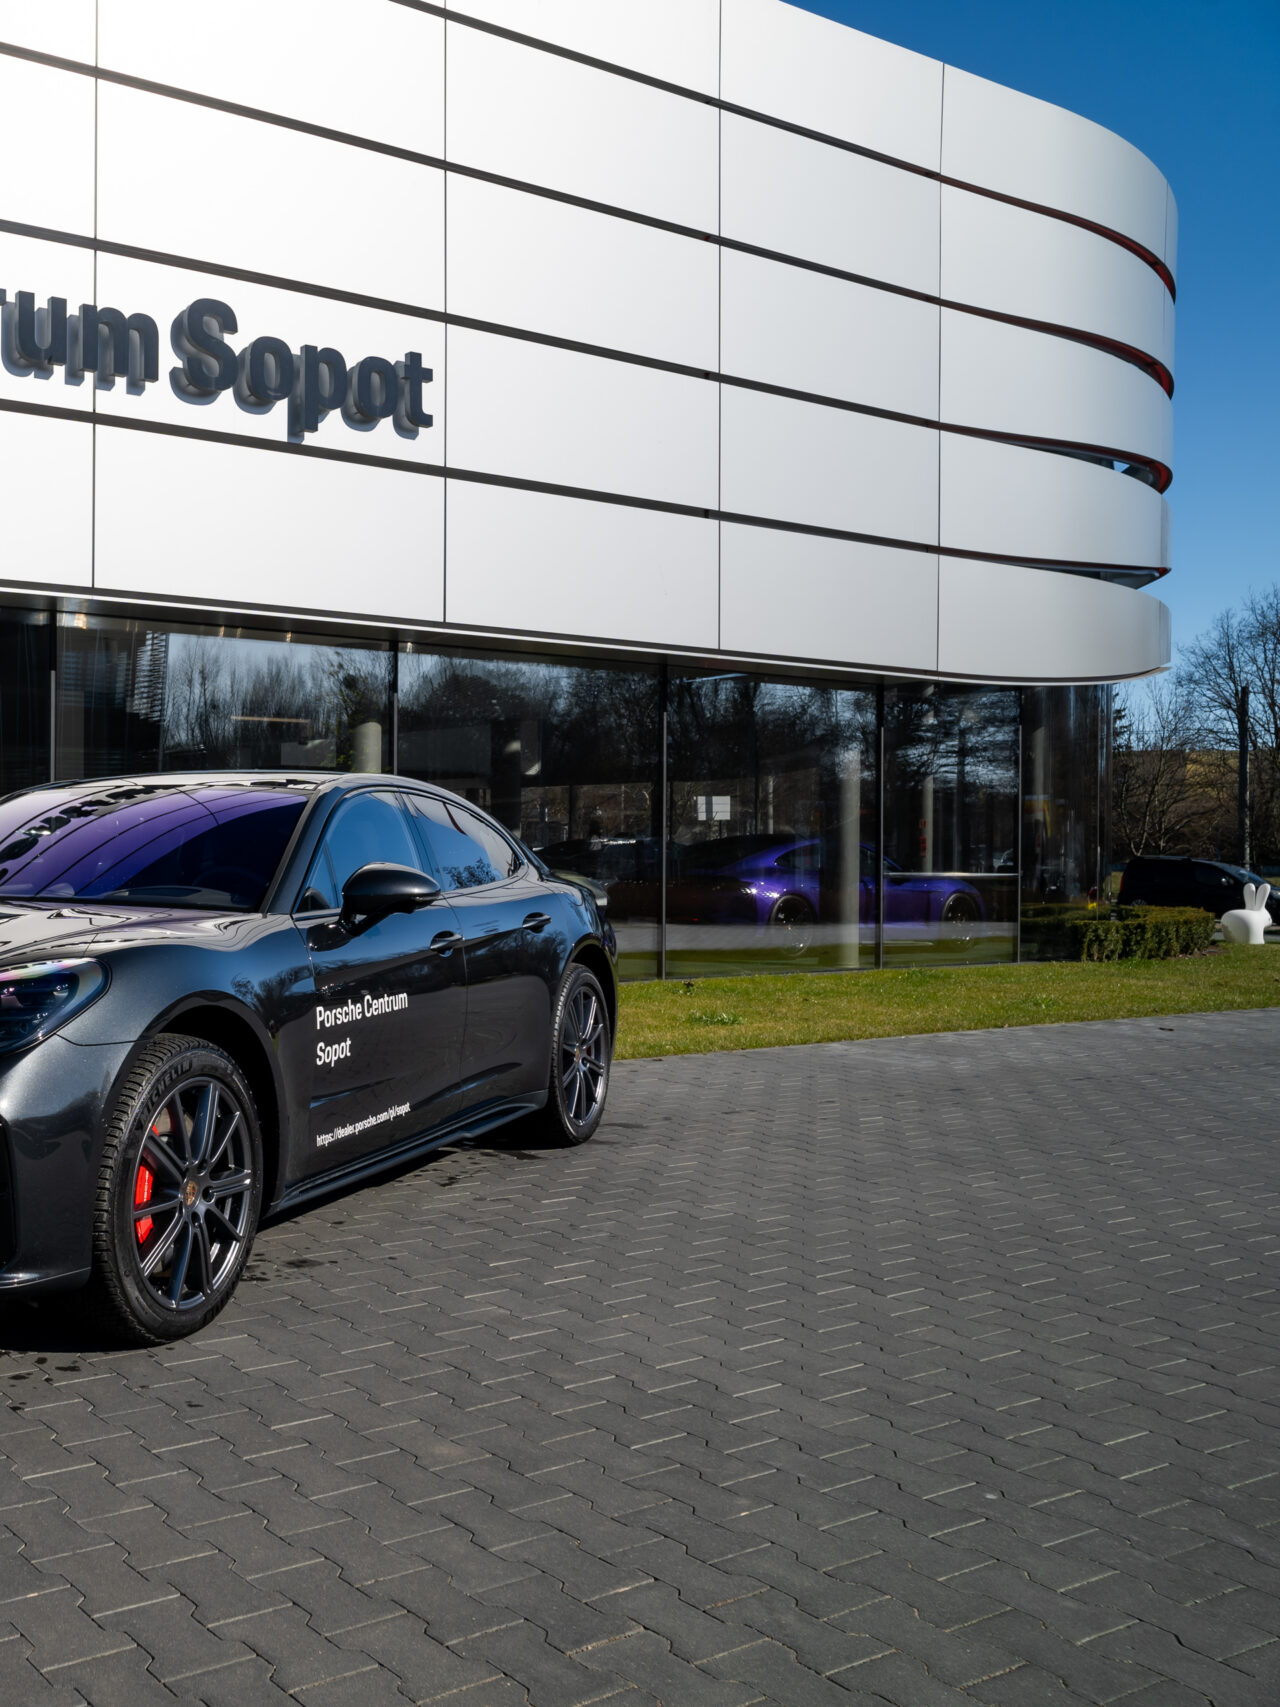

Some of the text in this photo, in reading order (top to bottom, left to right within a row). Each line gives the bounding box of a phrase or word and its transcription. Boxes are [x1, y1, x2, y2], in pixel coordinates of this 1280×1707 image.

[187, 298, 434, 433] Sopot
[316, 992, 409, 1030] Porsche Centrum
[316, 1037, 351, 1067] Sopot
[316, 1102, 411, 1147] https://dealer.porsche.com/pl/sopot
